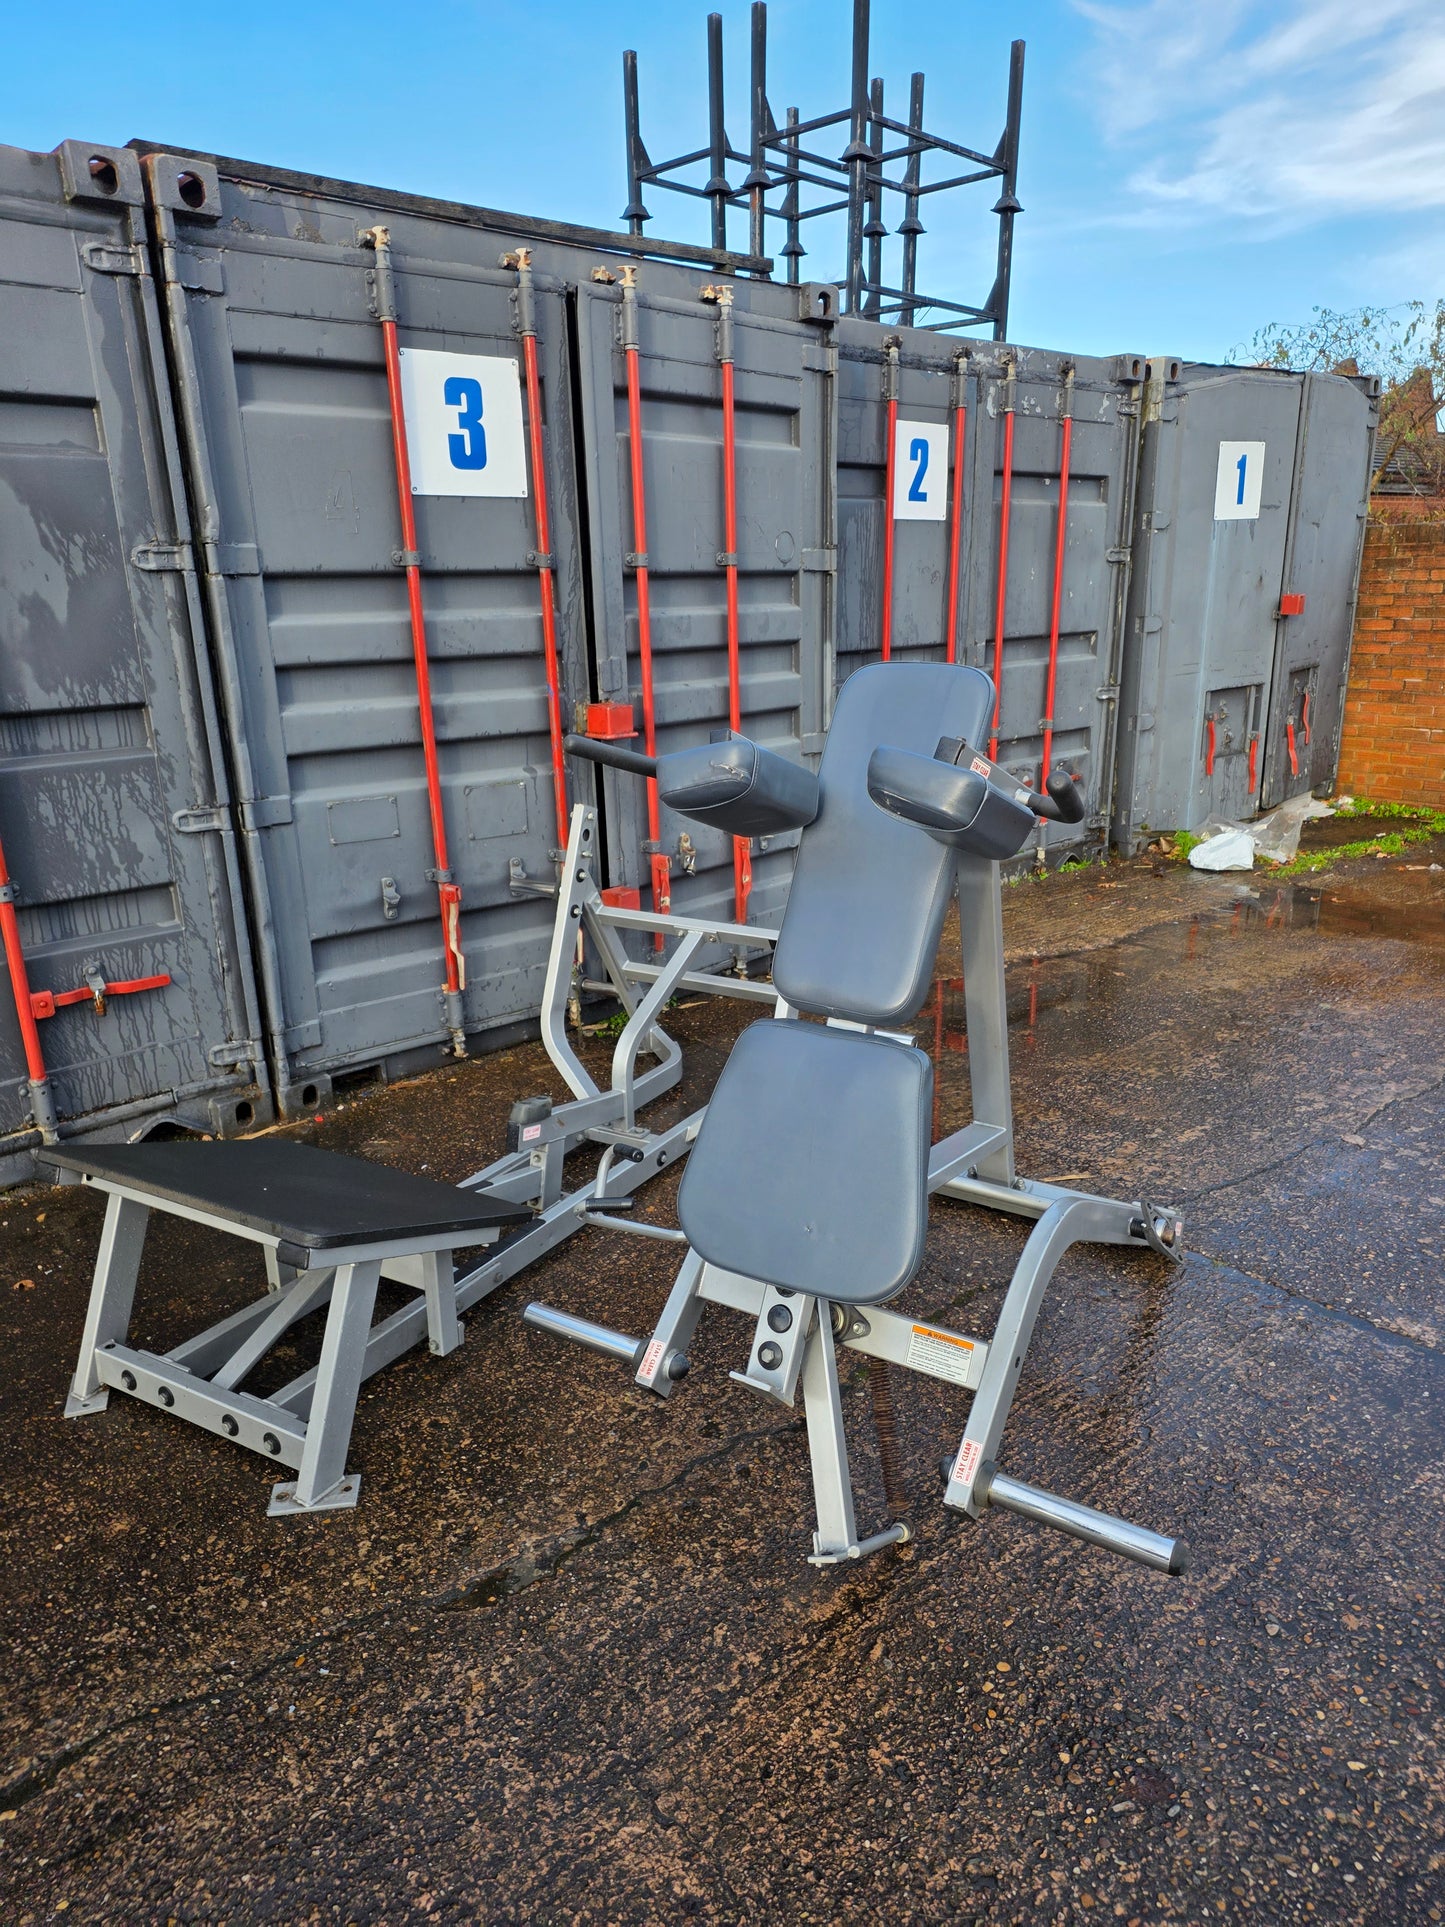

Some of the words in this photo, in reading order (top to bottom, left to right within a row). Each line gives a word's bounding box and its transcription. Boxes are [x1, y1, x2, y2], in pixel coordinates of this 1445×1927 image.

[444, 377, 487, 470] 3
[908, 438, 929, 502] 2
[1236, 454, 1247, 505] 1
[653, 1344, 663, 1358] STAY
[934, 1331, 959, 1345] WARNING
[955, 1462, 966, 1480] STAY
[962, 1442, 972, 1462] CLEAR
